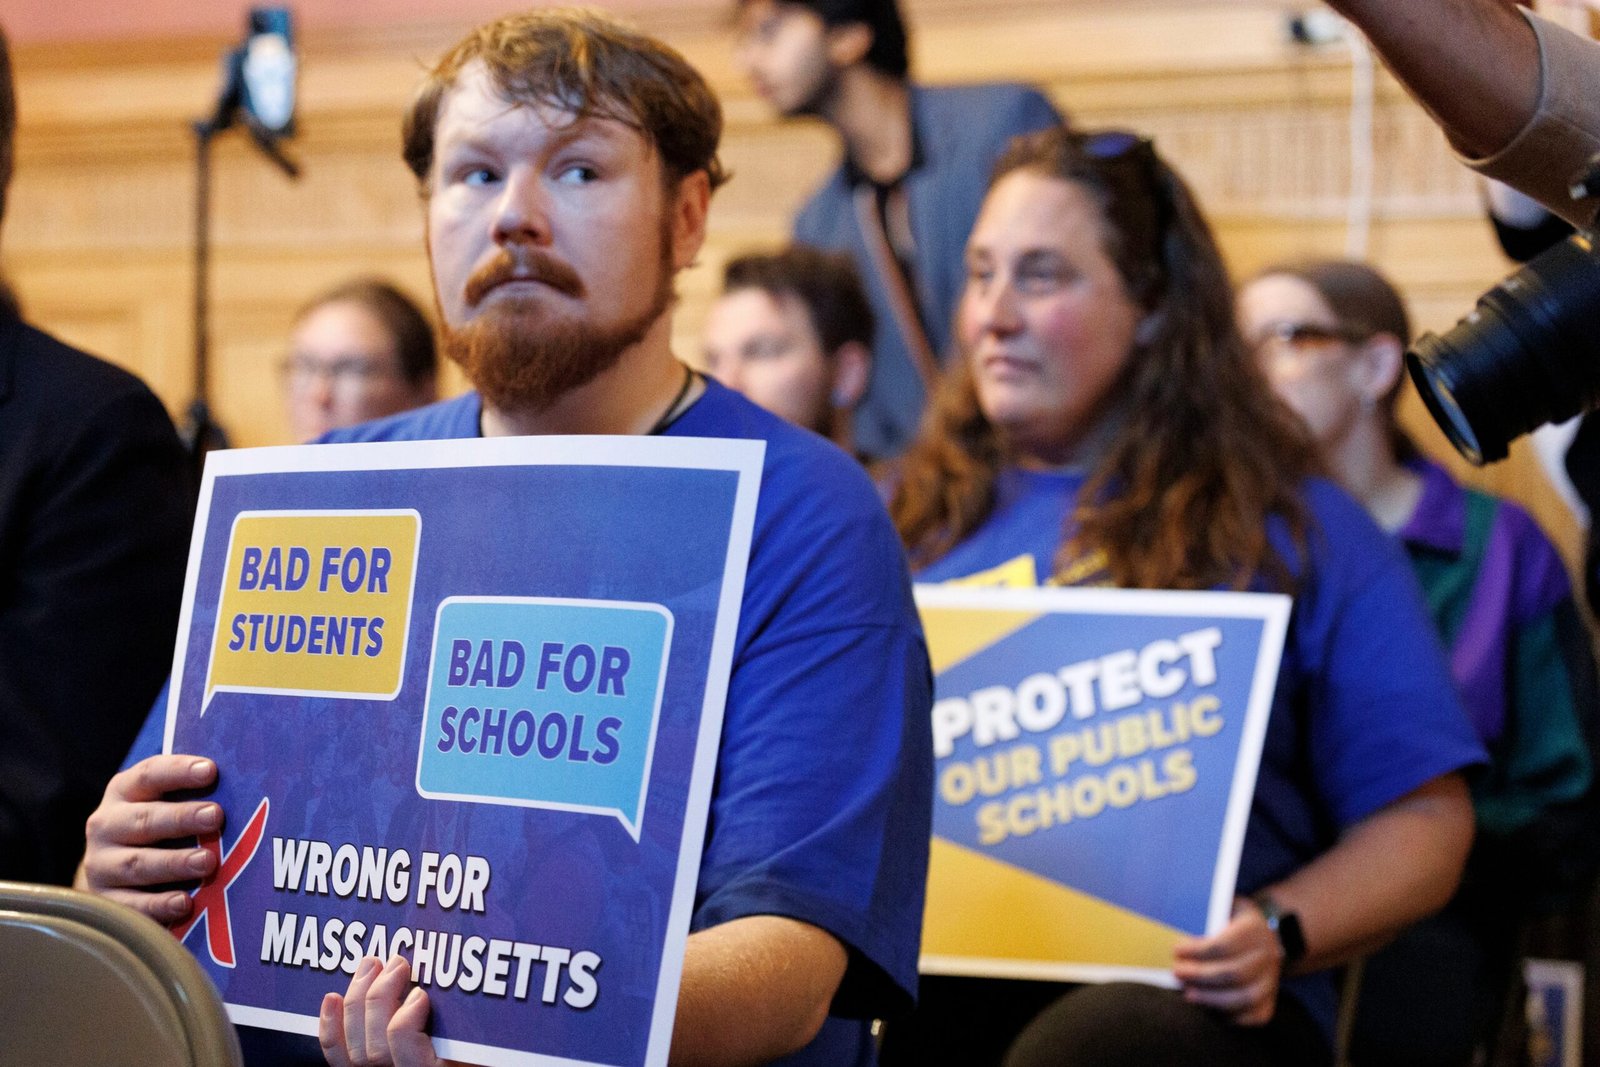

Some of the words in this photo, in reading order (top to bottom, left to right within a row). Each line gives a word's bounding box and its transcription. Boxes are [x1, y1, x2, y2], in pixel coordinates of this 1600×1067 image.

[239, 547, 310, 591] BAD
[319, 548, 392, 593] FOR
[229, 614, 385, 657] STUDENTS
[447, 639, 525, 688] BAD
[537, 643, 630, 696] FOR
[931, 627, 1222, 758] PROTECT
[437, 707, 622, 765] SCHOOLS
[940, 745, 1041, 805] OUR
[1050, 696, 1224, 777] PUBLIC
[977, 751, 1196, 845] SCHOOLS
[272, 838, 410, 903] WRONG
[417, 852, 491, 912] FOR
